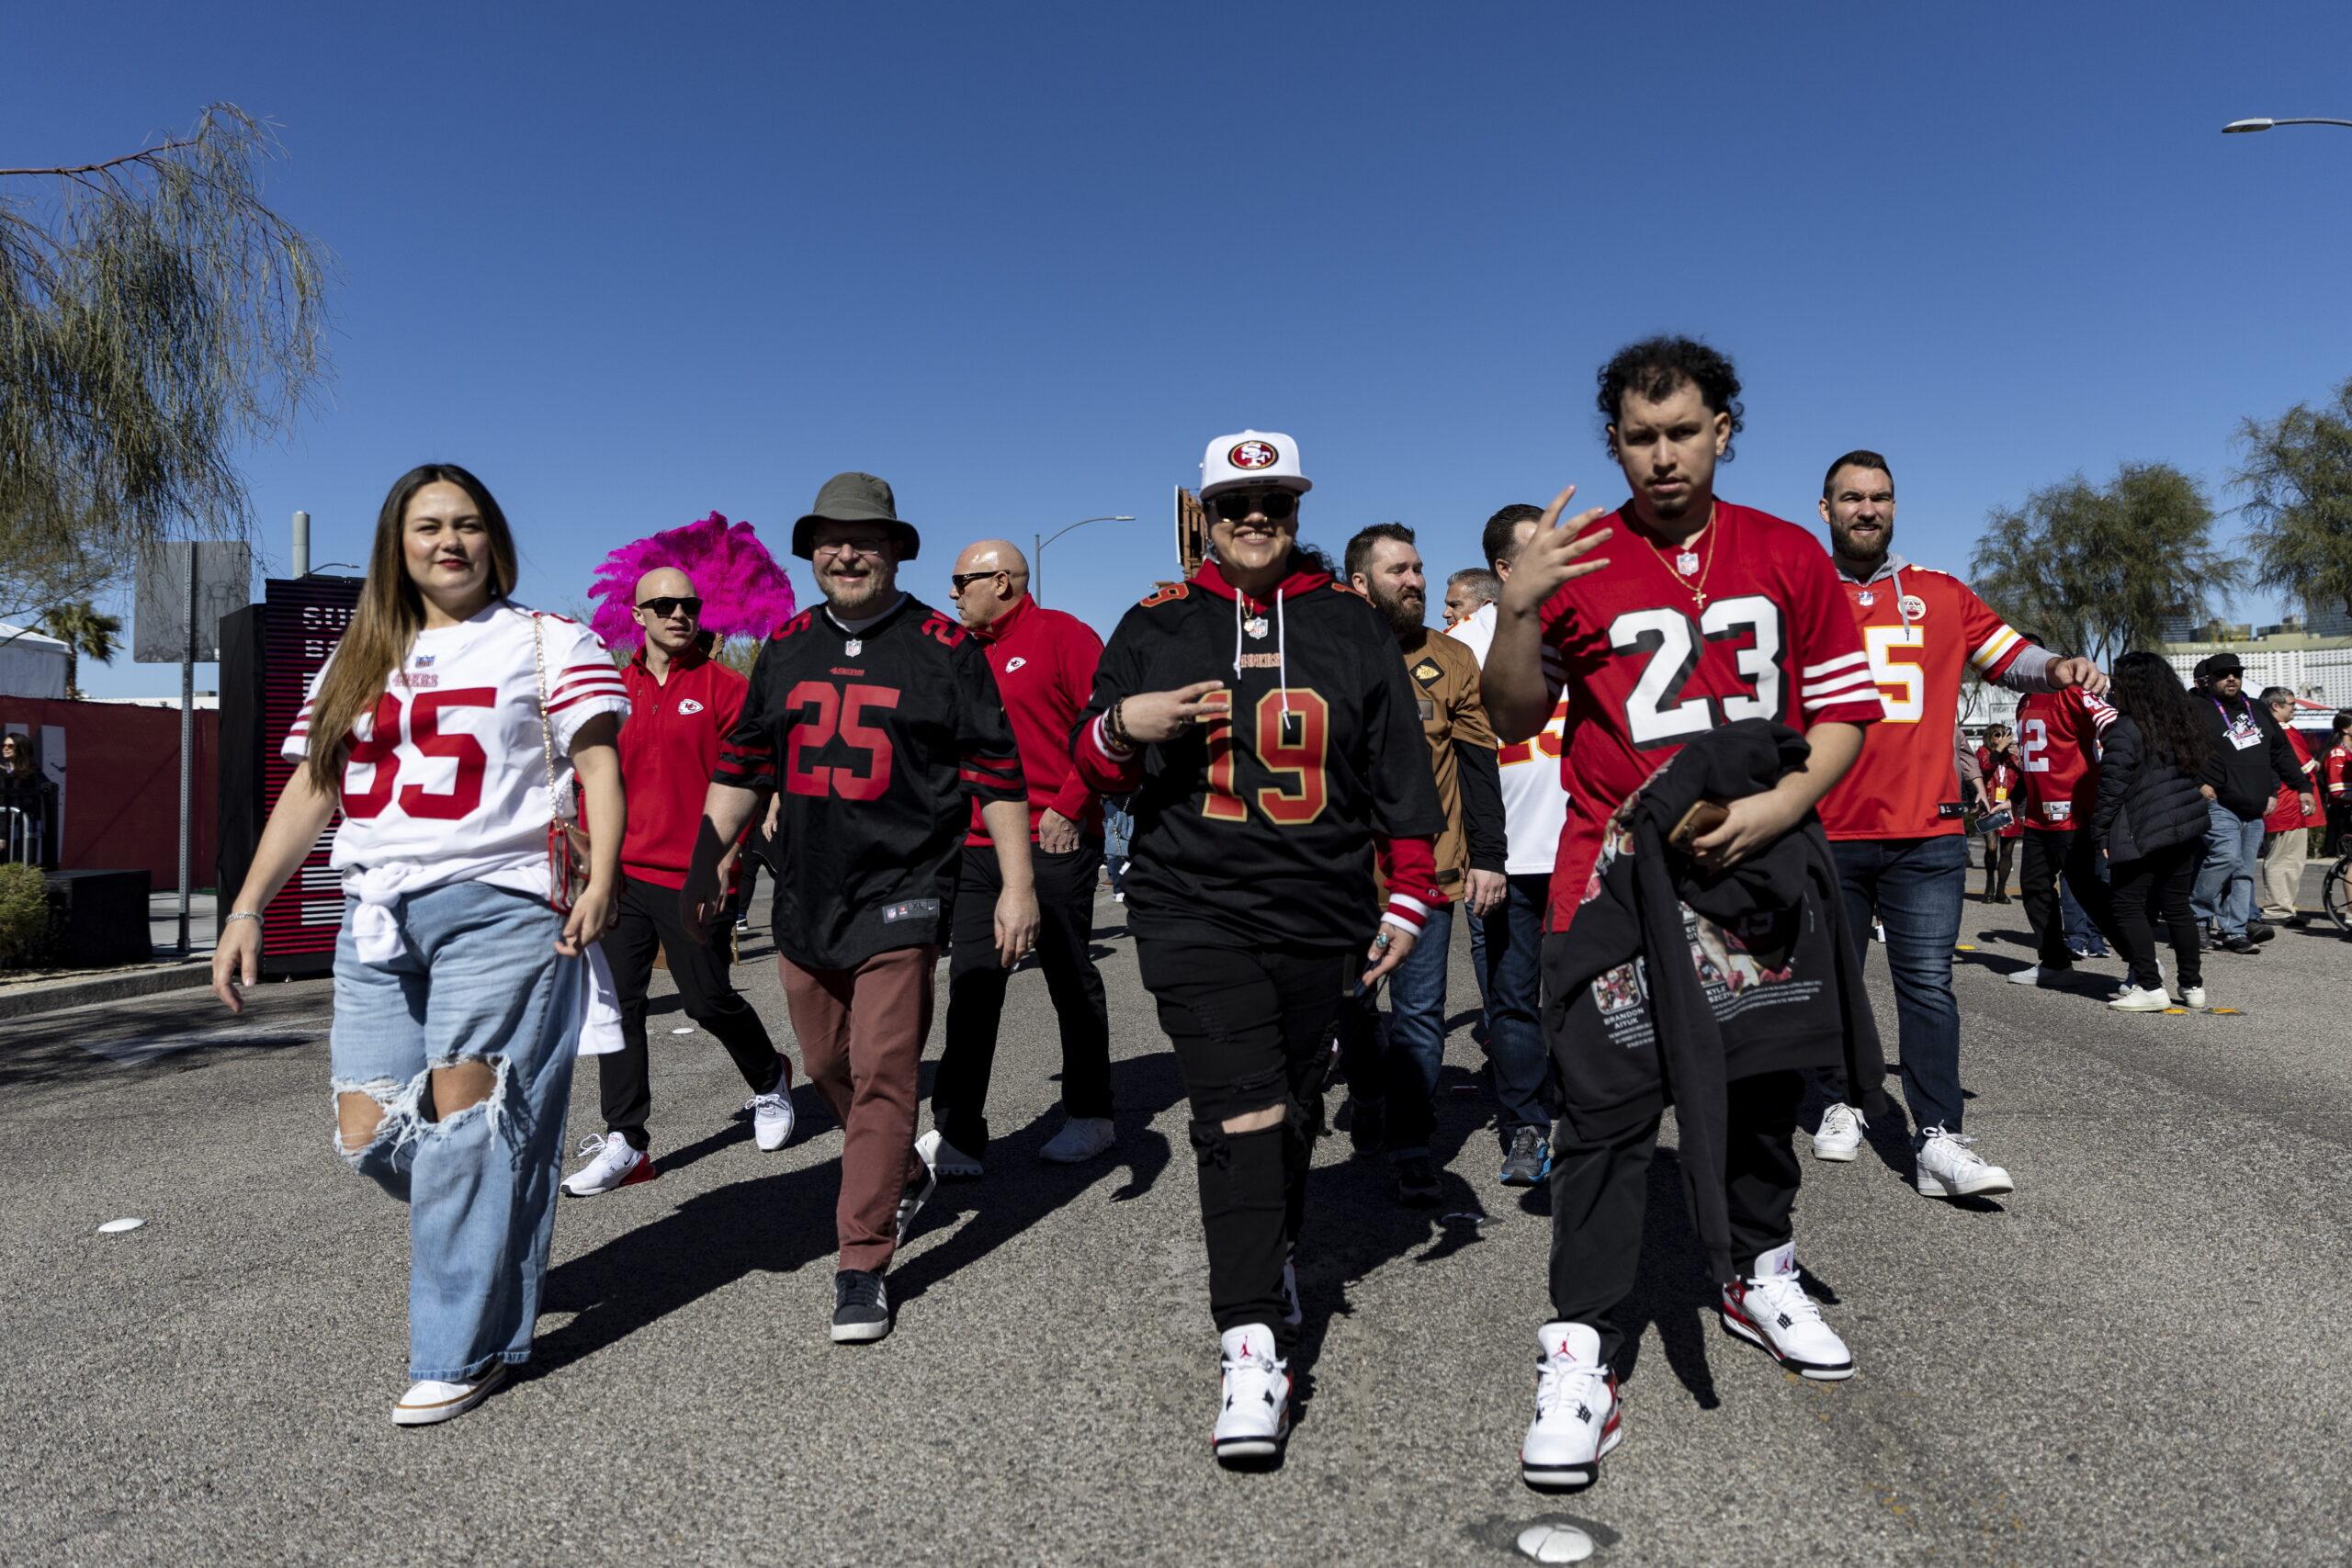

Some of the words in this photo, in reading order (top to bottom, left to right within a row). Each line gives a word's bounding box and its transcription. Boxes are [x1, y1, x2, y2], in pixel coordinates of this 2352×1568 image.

[302, 607, 356, 631] SU
[1607, 593, 1787, 749] 23
[2001, 718, 2016, 727] MUS
[786, 681, 901, 801] 25
[1193, 687, 1329, 825] 19
[1603, 1007, 1645, 1026] BRANDON
[1614, 1017, 1639, 1030] AIYUK
